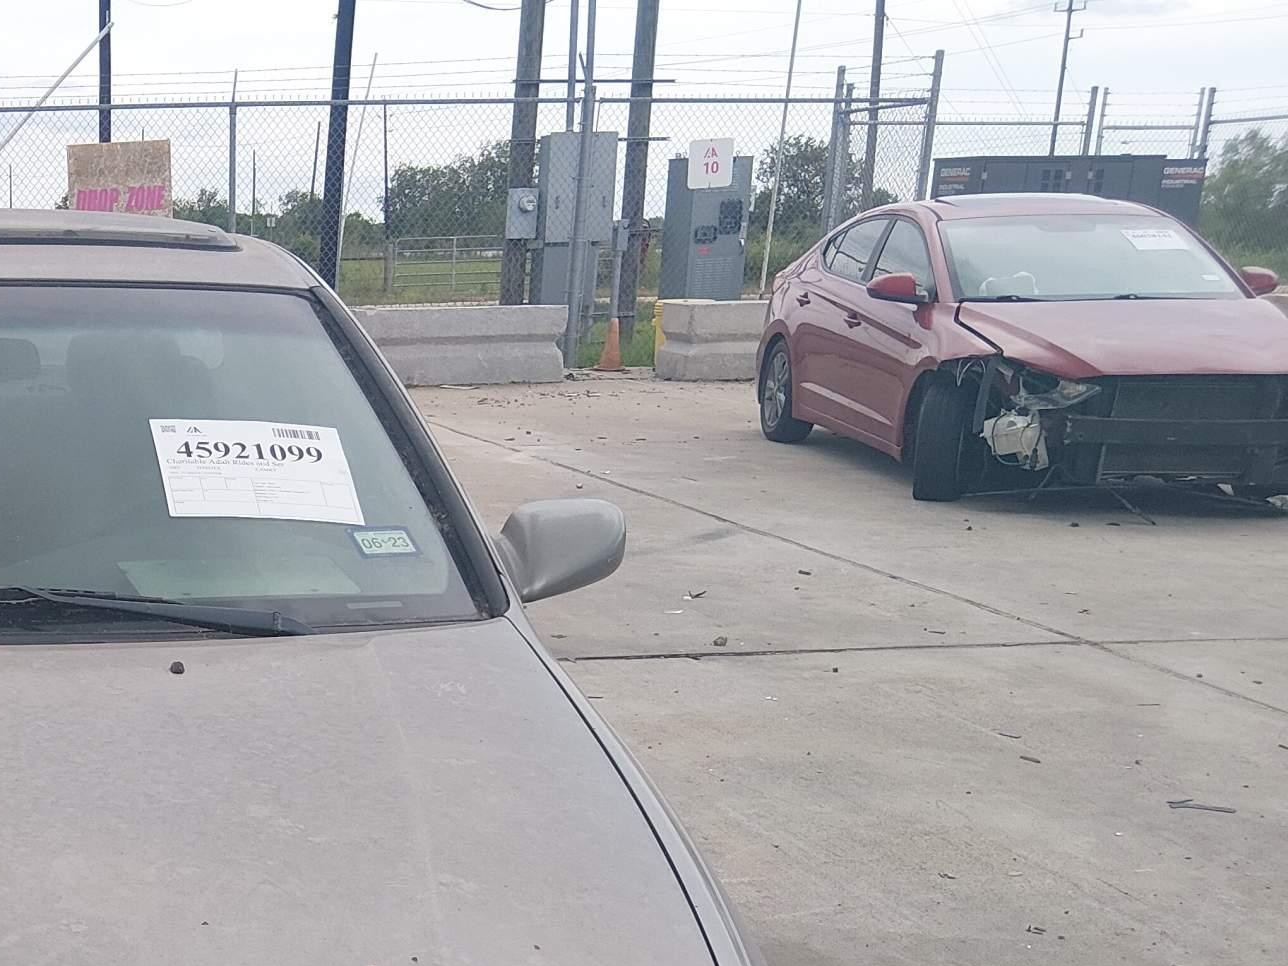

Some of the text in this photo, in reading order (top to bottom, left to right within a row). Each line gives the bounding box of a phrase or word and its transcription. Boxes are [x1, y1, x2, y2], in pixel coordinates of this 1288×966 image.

[703, 161, 719, 174] 10
[76, 184, 165, 212] DROP ZONE
[177, 441, 323, 464] 45921099
[361, 536, 409, 549] 06 23
